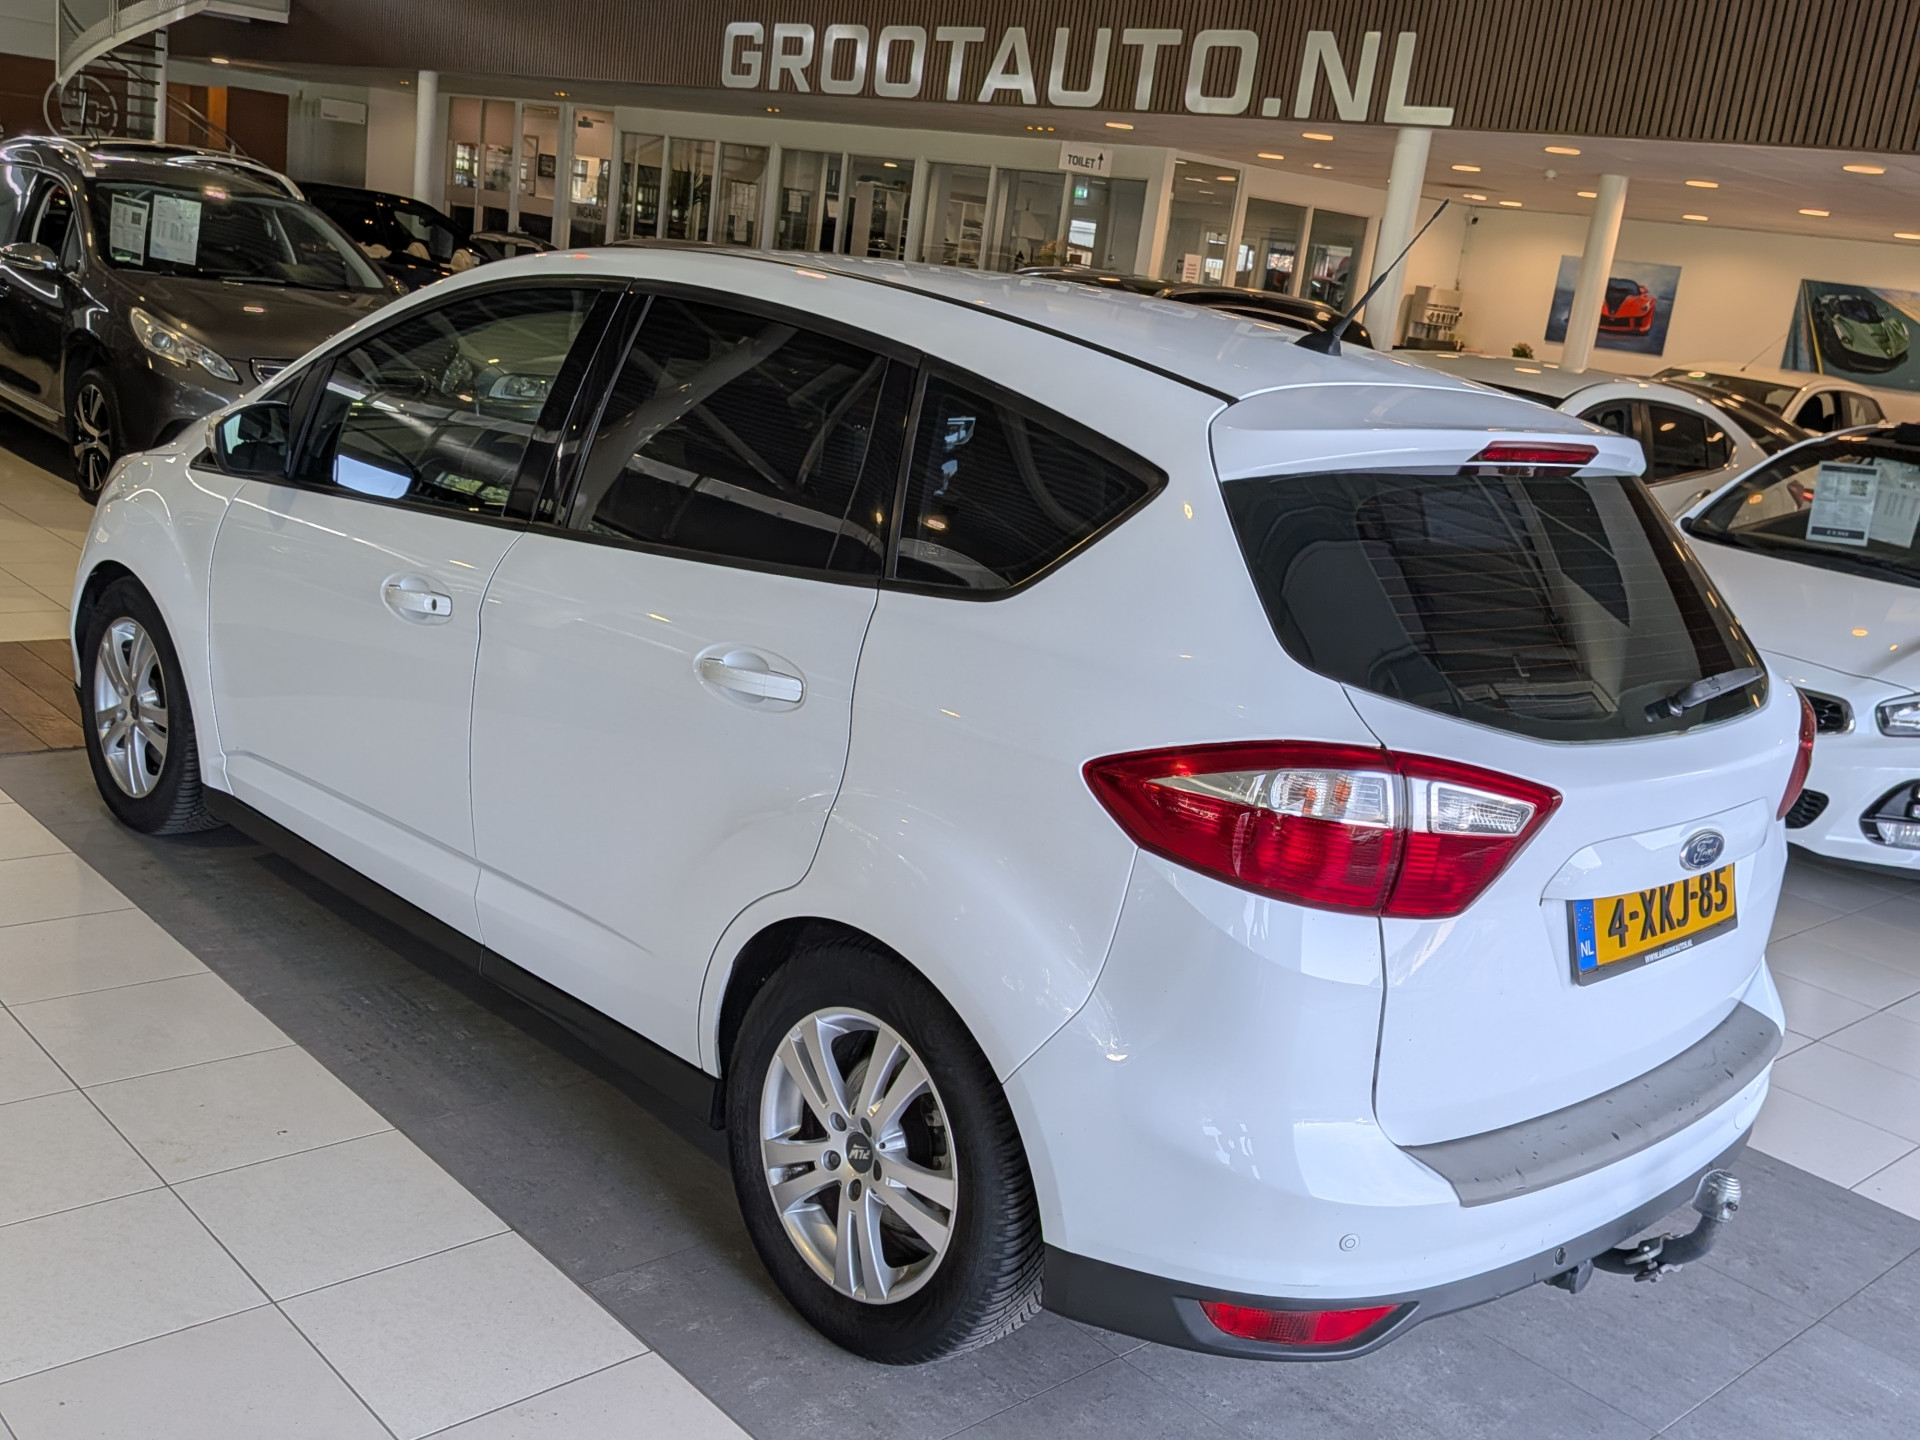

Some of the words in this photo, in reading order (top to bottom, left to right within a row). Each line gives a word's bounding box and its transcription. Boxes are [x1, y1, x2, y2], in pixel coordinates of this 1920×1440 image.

[721, 21, 1455, 127] GROOTAUTO.NL
[1067, 154, 1096, 169] TOILET
[576, 206, 602, 220] INGANG
[1693, 838, 1720, 864] Ford
[1608, 866, 1728, 948] 4-XKJ-85
[1580, 940, 1595, 958] NL
